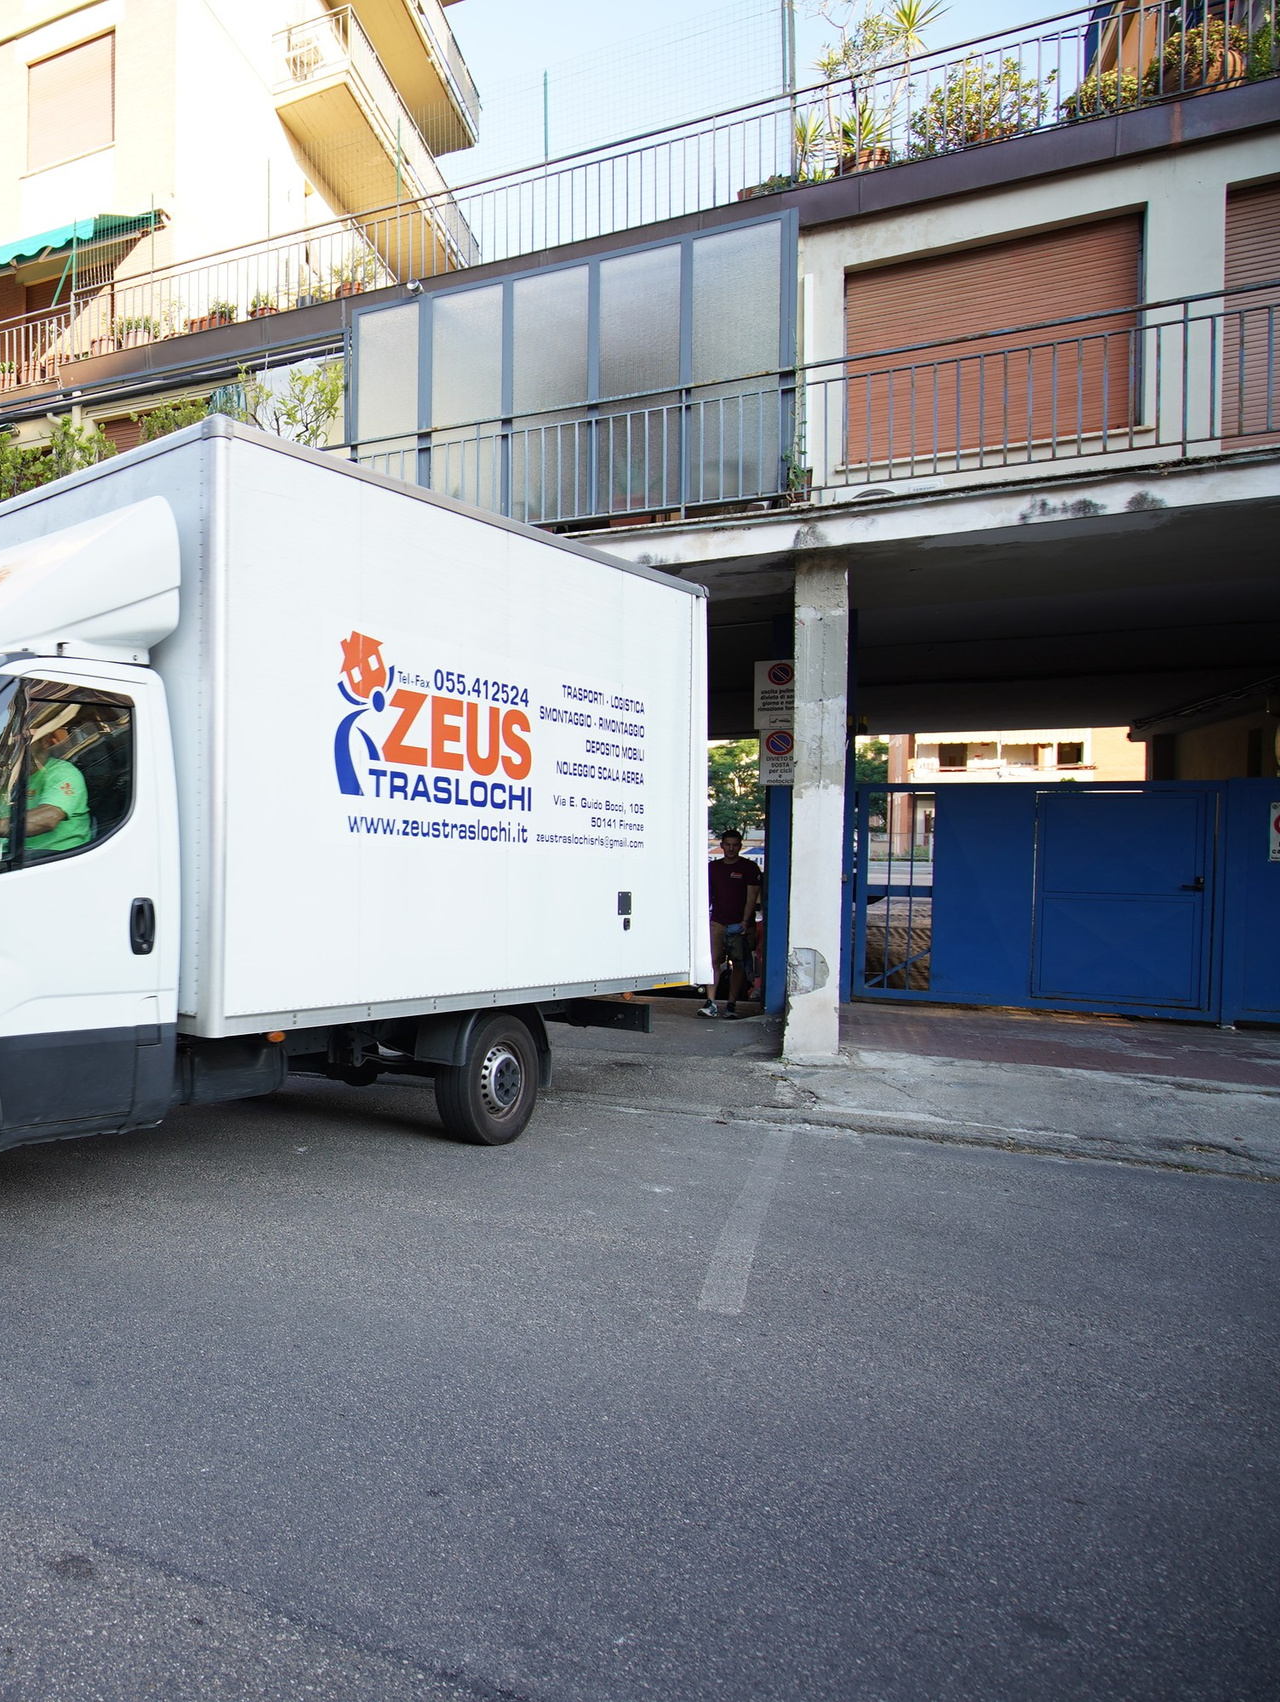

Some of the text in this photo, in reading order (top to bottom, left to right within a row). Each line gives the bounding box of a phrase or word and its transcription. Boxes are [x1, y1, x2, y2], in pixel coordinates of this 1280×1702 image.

[398, 669, 530, 708] Tel-Fax 055.412524
[562, 684, 605, 706] TRASPORTI
[611, 695, 645, 714] LOGISTICA
[381, 688, 532, 781] ZEUS
[540, 705, 592, 728] SMONTAGGIO
[599, 716, 645, 738] RIMONTAGGIO
[585, 739, 645, 762] DEPOSITO MOBILI
[556, 760, 645, 785] NOLEGGIO SCALA AEREA
[368, 768, 532, 812] TRASLOCHI
[553, 794, 567, 807] Via
[569, 796, 578, 807] E.
[581, 797, 603, 810] Guido
[629, 803, 645, 814] 105
[347, 815, 529, 843] www.zeustraslochi.it
[591, 817, 645, 832] 50141 Firenze
